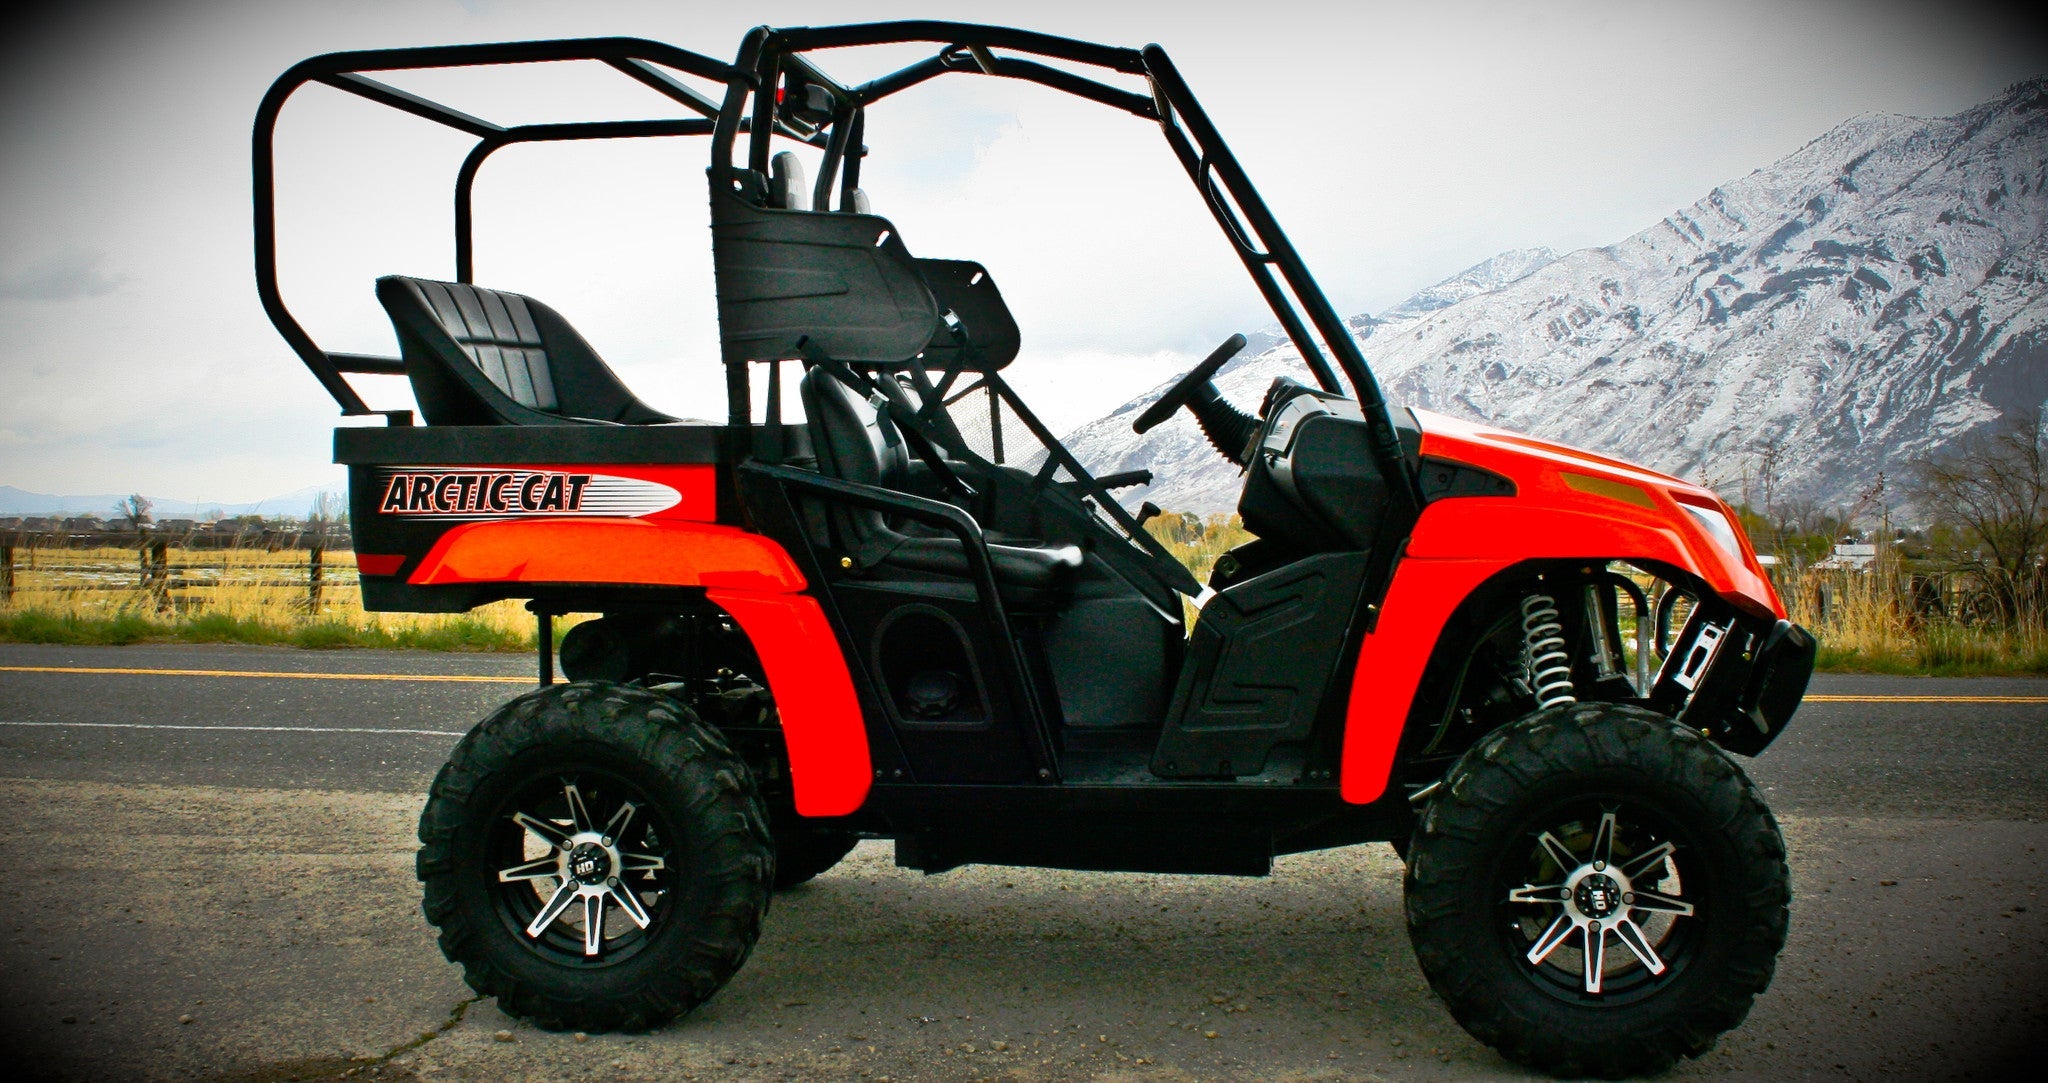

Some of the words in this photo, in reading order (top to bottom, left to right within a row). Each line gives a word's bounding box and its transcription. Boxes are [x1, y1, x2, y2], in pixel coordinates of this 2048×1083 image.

[380, 473, 513, 512] ARCTIC
[518, 472, 593, 512] CAT
[576, 860, 594, 875] HD
[1592, 890, 1606, 910] HD
